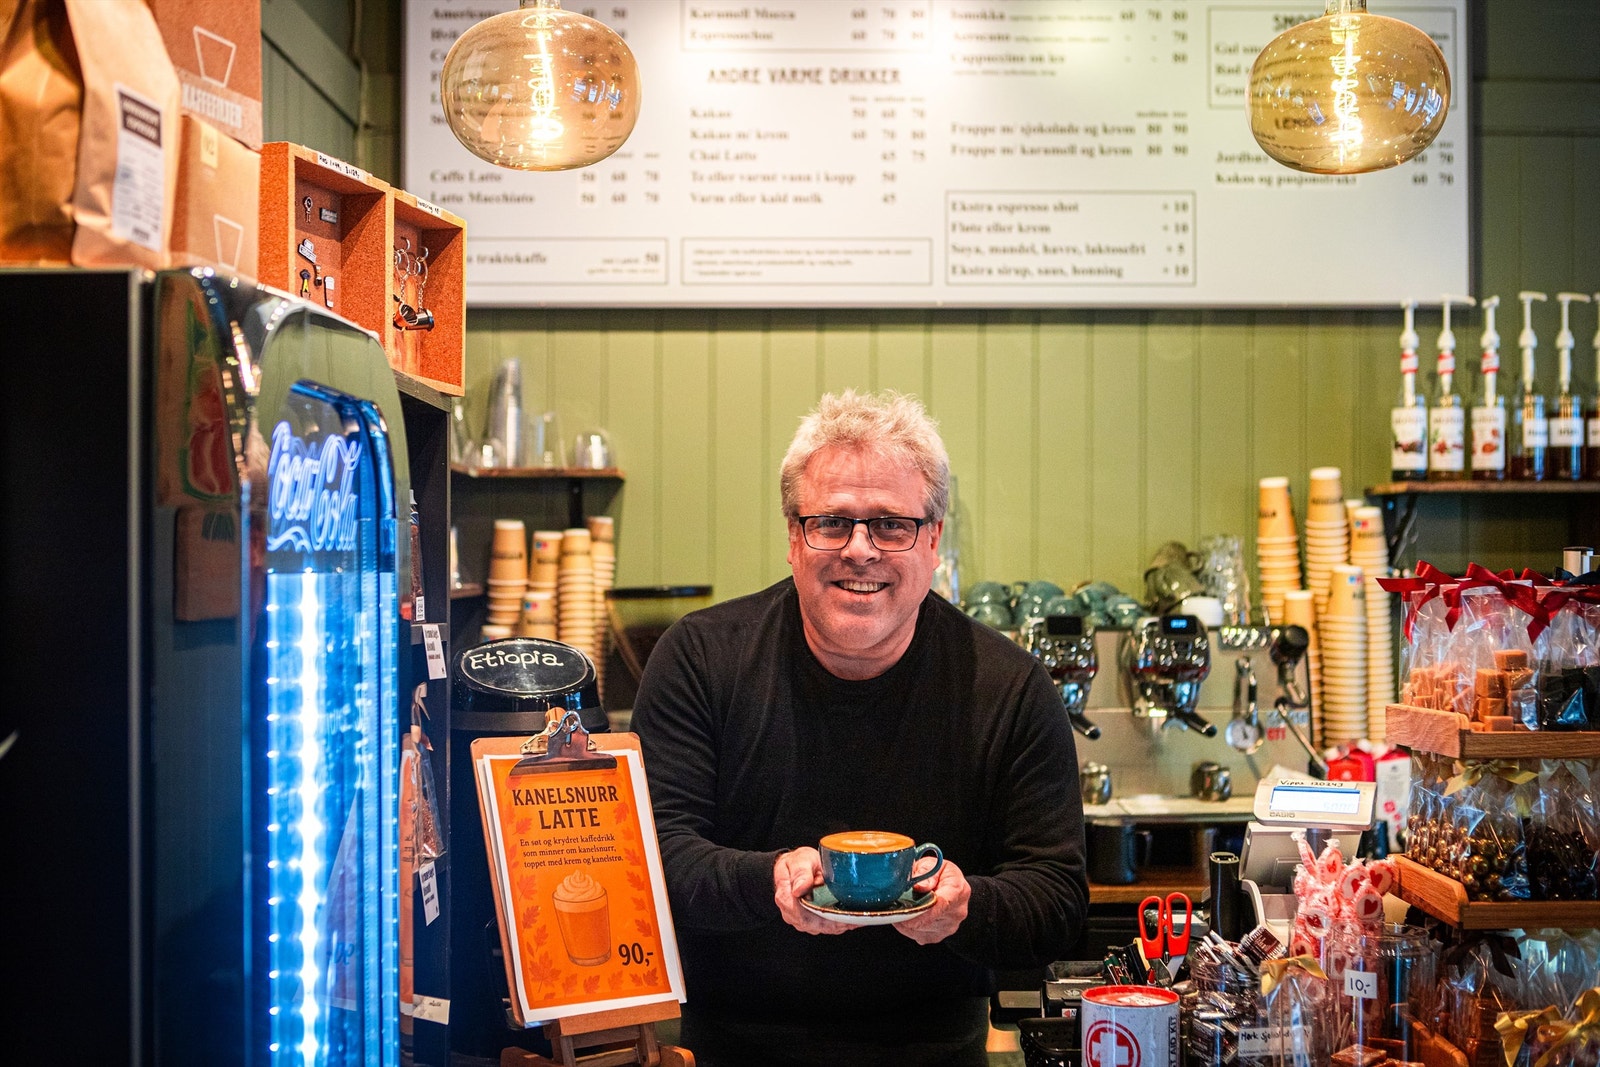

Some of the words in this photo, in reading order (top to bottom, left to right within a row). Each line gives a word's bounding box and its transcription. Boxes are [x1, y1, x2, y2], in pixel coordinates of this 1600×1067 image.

[709, 68, 760, 84] ANDRE
[769, 68, 822, 84] VARME
[830, 68, 901, 84] DRIKKER
[690, 109, 731, 119] Kakao
[690, 129, 731, 140] Kakao
[690, 150, 720, 161] Chai
[725, 150, 757, 161] Latte
[469, 171, 502, 182] Latte
[431, 193, 462, 204] Latte
[691, 193, 724, 204] Varm
[761, 193, 788, 204] kald
[793, 193, 822, 204] melk
[951, 202, 993, 212] Ekstra
[997, 204, 1049, 215] espresso
[1054, 202, 1078, 212] shot
[1086, 243, 1145, 255] laktosefri
[951, 265, 993, 276] Ekstra
[1072, 265, 1123, 278] honning
[469, 650, 564, 670] Etiopia
[512, 785, 619, 806] KANELSNURR
[539, 808, 600, 829] LATTE
[520, 839, 529, 847] En
[553, 837, 579, 846] krydret
[581, 834, 615, 843] kaffedrikk
[579, 845, 616, 853] kanelsnurr,
[524, 860, 545, 869] toppet
[548, 858, 562, 866] med
[591, 855, 623, 863] kanelstrø.
[618, 942, 654, 967] 90,-
[1350, 977, 1371, 993] 10,-
